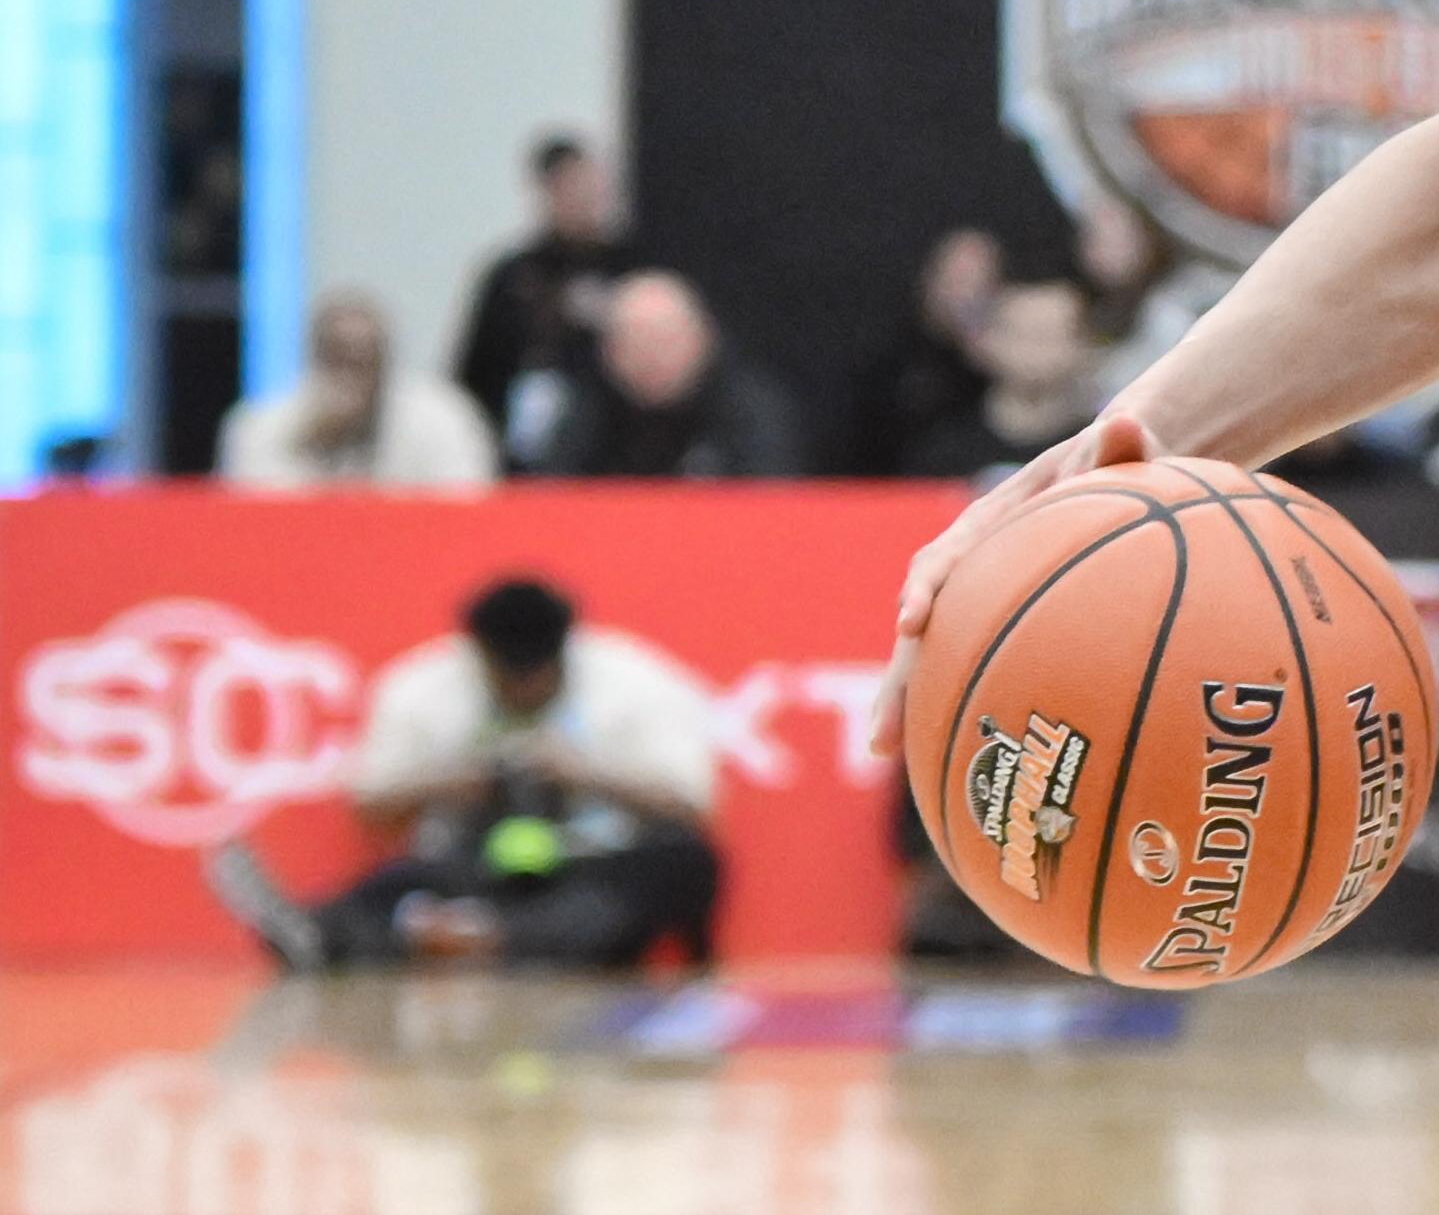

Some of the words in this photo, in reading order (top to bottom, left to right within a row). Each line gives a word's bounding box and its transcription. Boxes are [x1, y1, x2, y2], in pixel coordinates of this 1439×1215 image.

[983, 747, 1018, 842] SPALDING
[1001, 713, 1071, 902] HOOPHALL
[1051, 735, 1085, 806] CLASSIC
[1140, 680, 1286, 976] SPALDING
